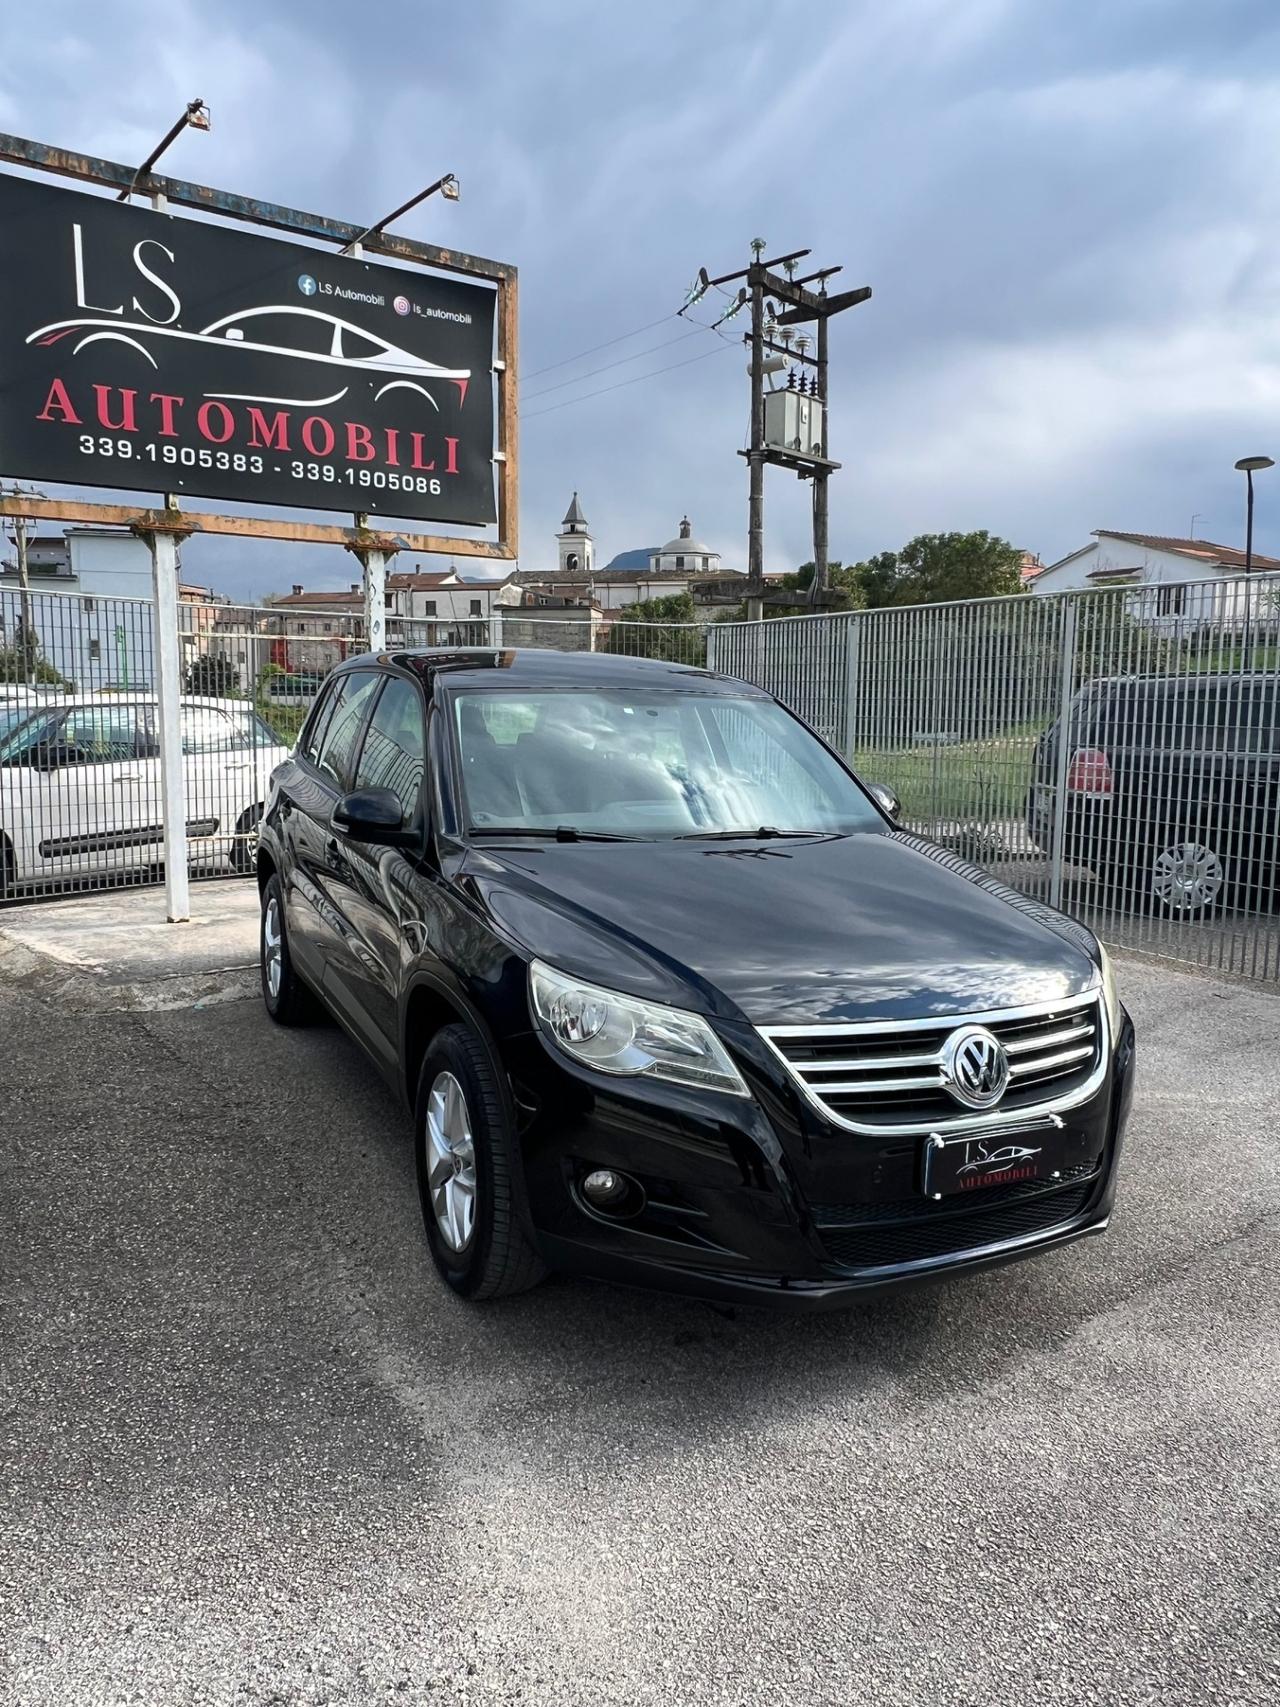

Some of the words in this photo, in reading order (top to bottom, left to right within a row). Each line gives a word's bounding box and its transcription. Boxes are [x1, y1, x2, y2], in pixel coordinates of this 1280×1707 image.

[73, 223, 181, 324] LS
[318, 281, 333, 294] LS
[334, 286, 385, 306] Automobili
[413, 303, 472, 324] ls_automobili
[35, 378, 459, 474] AUTOMOBILI
[79, 435, 263, 474] 339.1905383
[291, 461, 441, 495] 339.1905086
